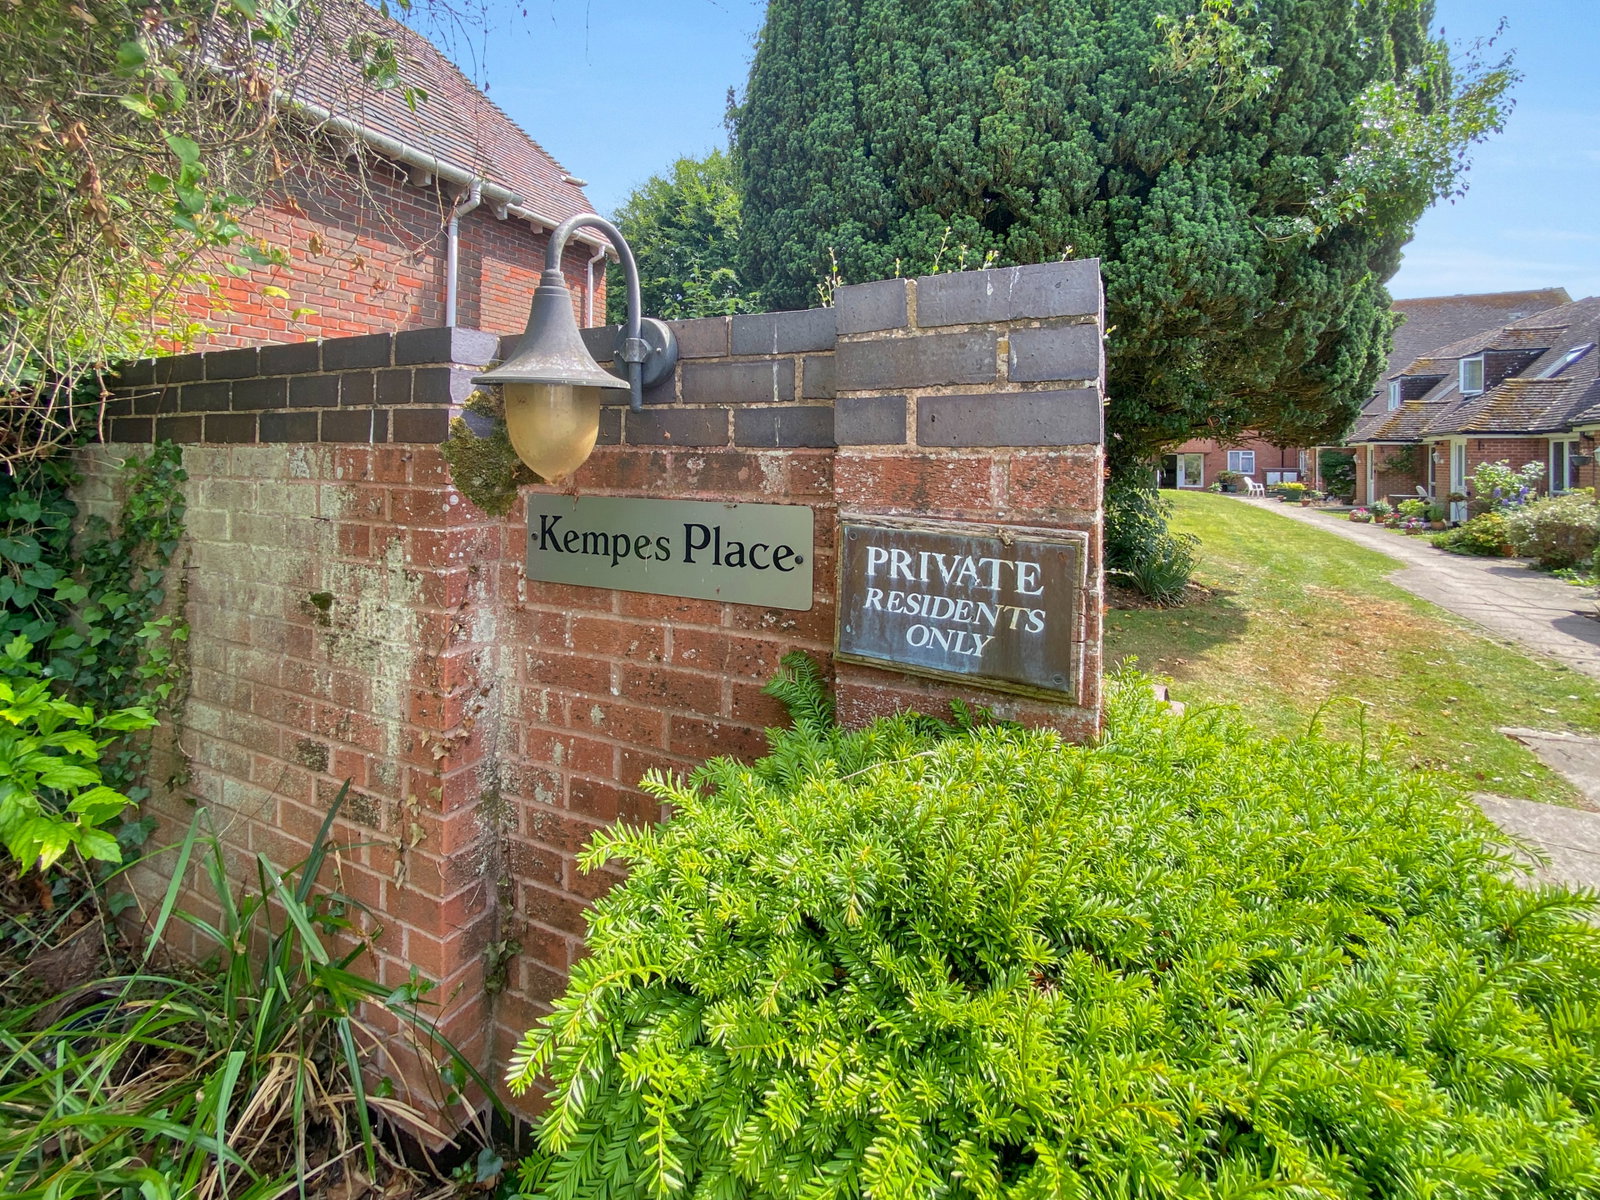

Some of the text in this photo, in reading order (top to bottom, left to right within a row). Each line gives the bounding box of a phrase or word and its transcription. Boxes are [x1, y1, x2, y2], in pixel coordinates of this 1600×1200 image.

[539, 515, 796, 572] Kempes Place
[865, 546, 1045, 596] PRIVATE
[863, 588, 1046, 633] RESIDENTS
[906, 624, 995, 657] ONLY
